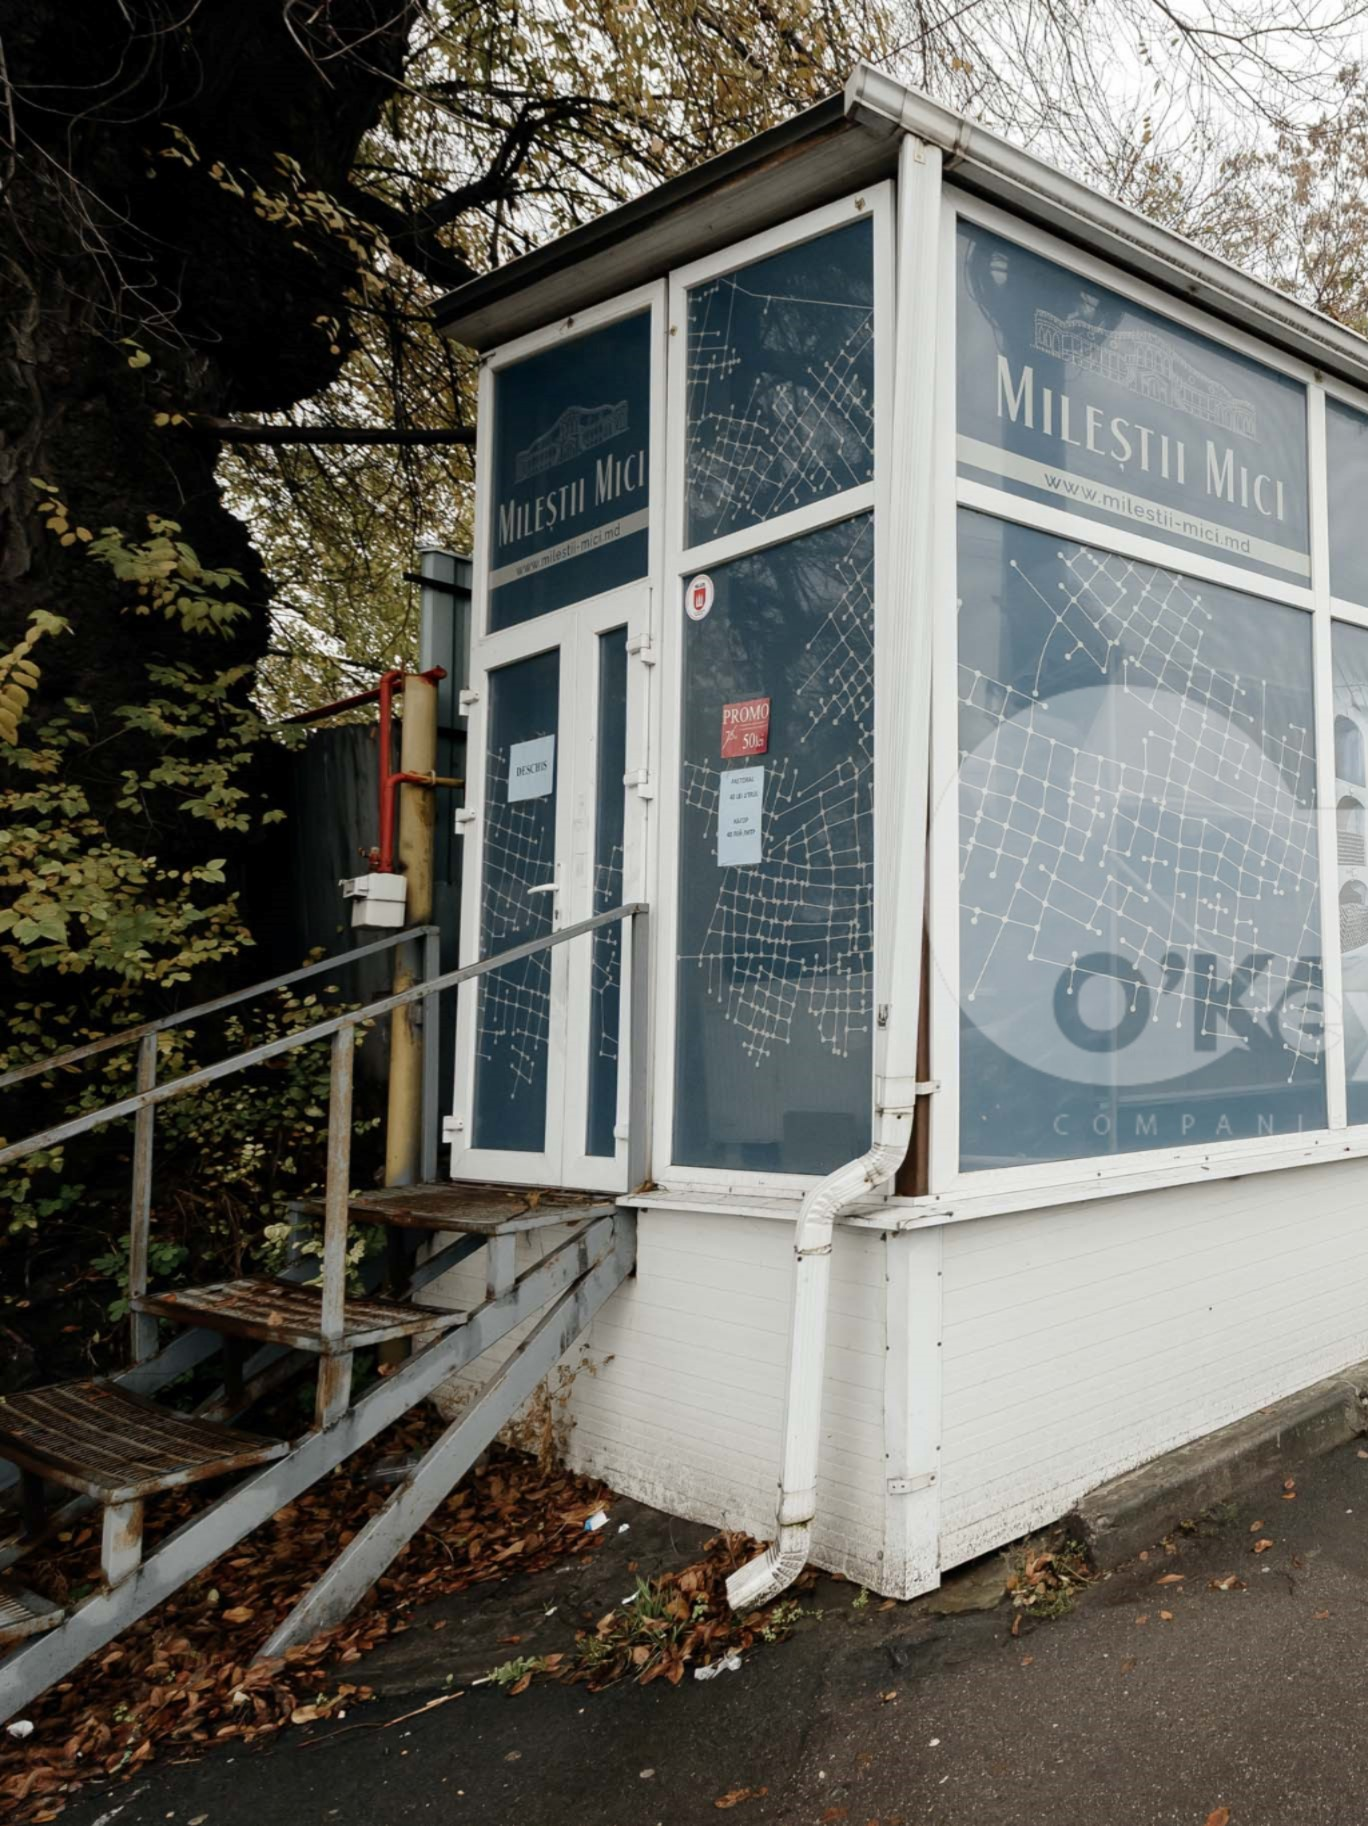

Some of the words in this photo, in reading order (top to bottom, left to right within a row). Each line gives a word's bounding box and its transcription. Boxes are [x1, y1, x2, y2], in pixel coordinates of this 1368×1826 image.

[1043, 472, 1251, 553] www.milestii-mici.md
[1206, 439, 1284, 521] MICI
[515, 523, 621, 576] www.milestii-mici.md
[723, 703, 769, 725] PROMO
